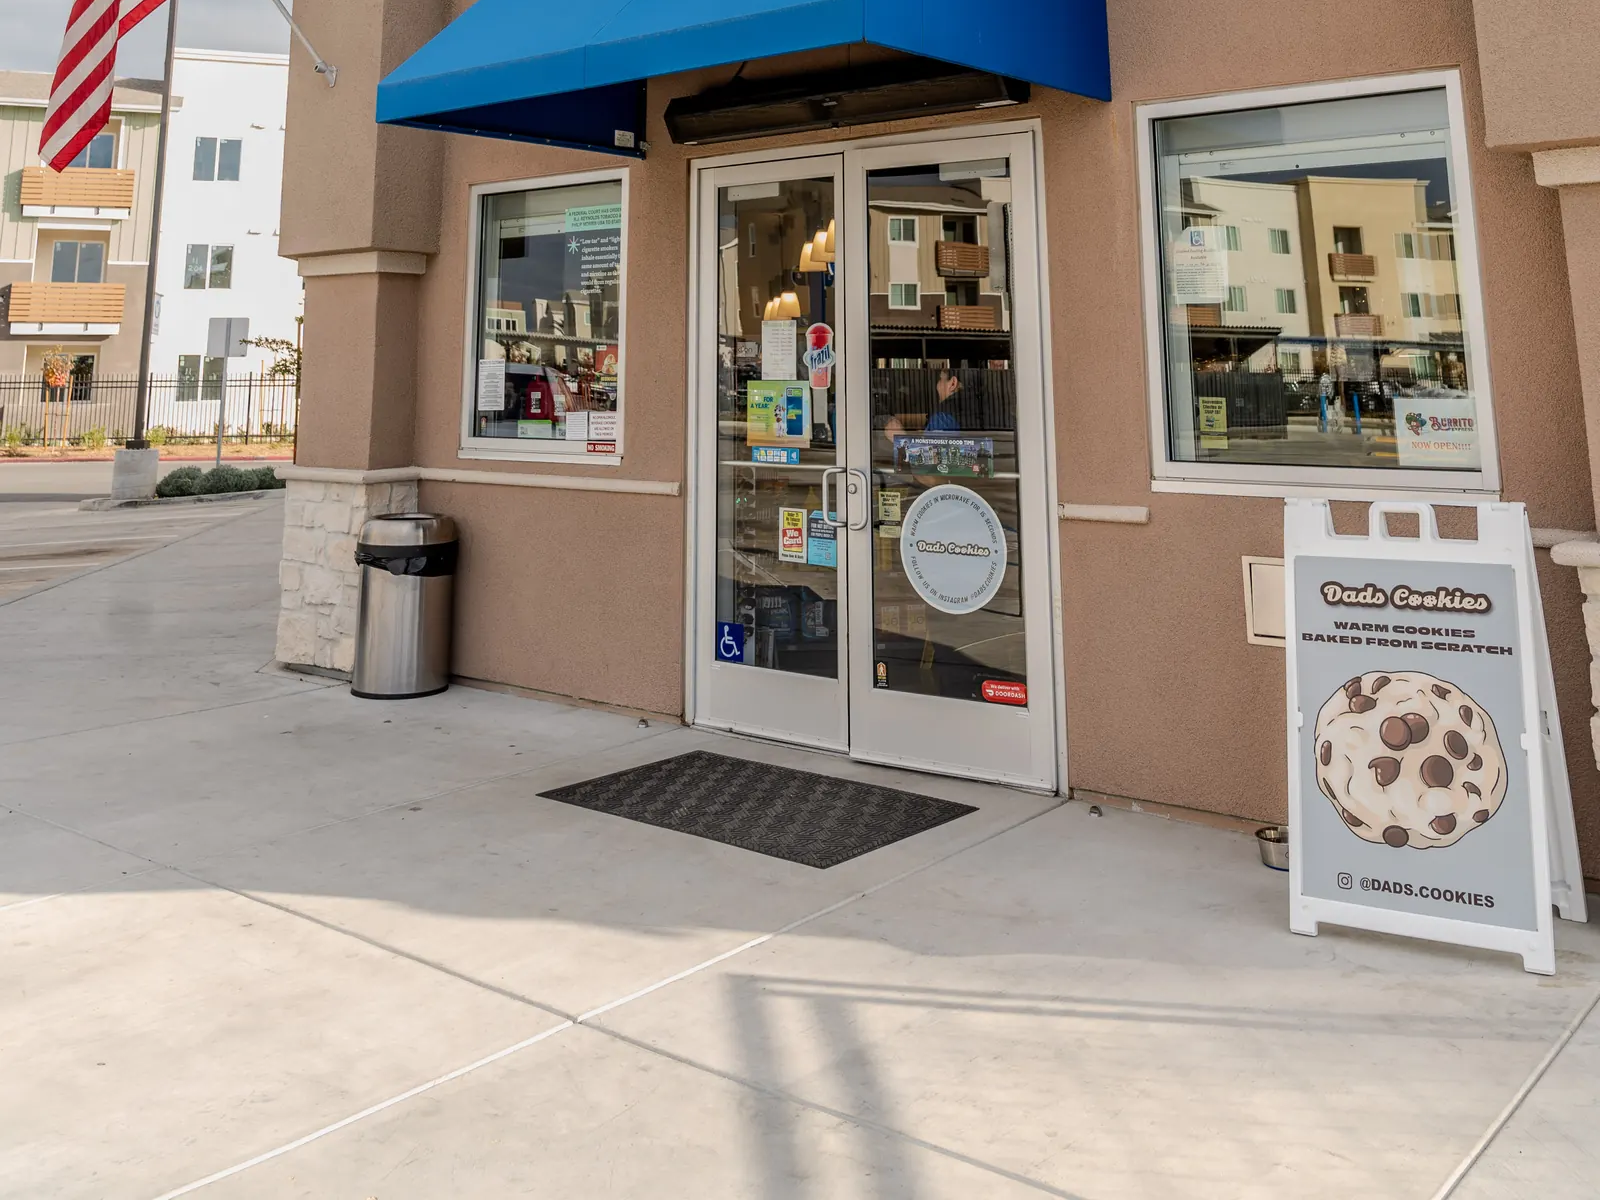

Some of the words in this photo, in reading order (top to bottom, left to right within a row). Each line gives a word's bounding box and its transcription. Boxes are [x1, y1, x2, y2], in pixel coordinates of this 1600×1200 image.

[810, 343, 831, 370] frazil
[1428, 416, 1474, 431] BURRITO
[595, 444, 615, 452] SMOKING
[1411, 440, 1431, 449] NOW
[910, 519, 920, 537] WARM
[916, 500, 933, 520] COOKIES
[933, 496, 940, 505] IN
[939, 493, 970, 505] MICROWAVE
[969, 501, 981, 511] FOR
[984, 517, 998, 544] SECONDS
[783, 536, 802, 545] Card
[785, 529, 799, 537] We
[916, 540, 946, 553] Dads
[947, 542, 990, 557] Cookies
[911, 555, 924, 580] FOLLOW
[922, 580, 930, 590] US
[929, 588, 938, 597] ON
[938, 592, 969, 604] INSTAGRAM
[1320, 581, 1387, 607] Dads
[1391, 585, 1492, 613] Cookies
[1333, 620, 1389, 634] WARM
[1391, 624, 1476, 639] COOKIES
[1301, 632, 1363, 646] BAKED
[1364, 636, 1419, 650] FROM
[1421, 640, 1513, 655] SCRATCH
[994, 691, 1026, 699] DOORDASH
[1359, 876, 1495, 909] @DADS.COOKIES
